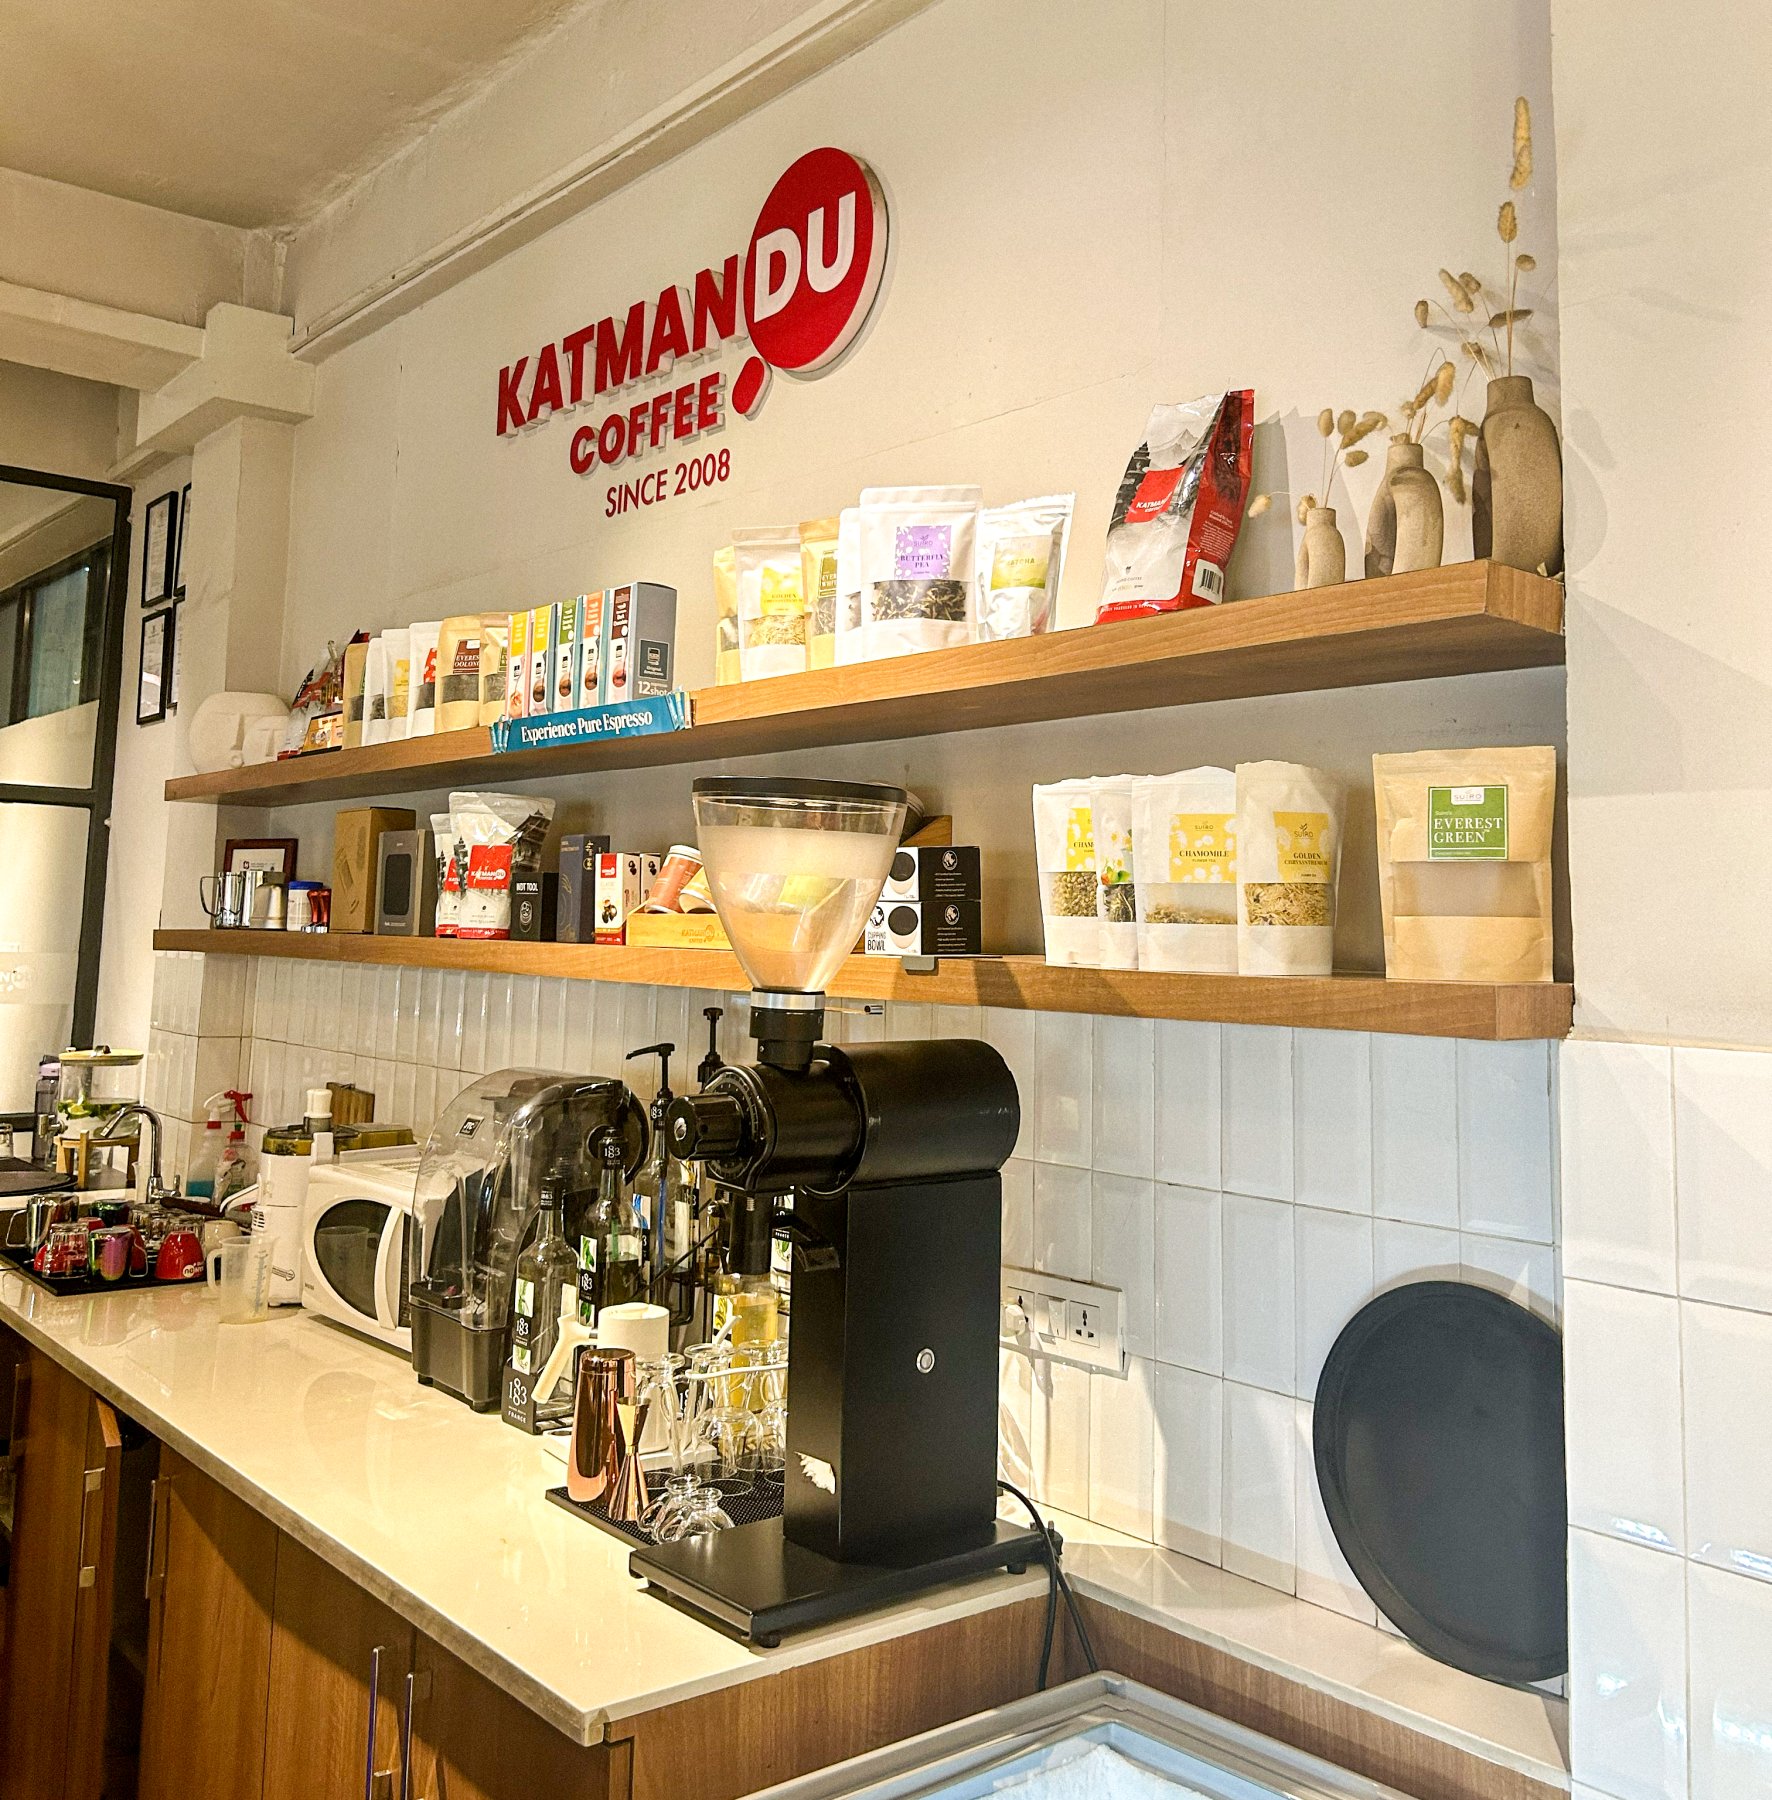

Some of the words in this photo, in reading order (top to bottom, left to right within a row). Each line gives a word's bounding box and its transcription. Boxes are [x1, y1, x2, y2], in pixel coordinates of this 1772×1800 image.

[570, 371, 722, 475] COFFEE
[605, 468, 667, 518] SINCE
[674, 448, 731, 496] 2008
[1007, 557, 1035, 566] ATCHA
[637, 681, 651, 695] 12
[520, 721, 577, 746] Experience
[577, 716, 603, 735] Pure
[602, 711, 653, 735] Espresso
[1434, 817, 1503, 830] EVEREST
[526, 882, 539, 892] TOOL
[867, 939, 886, 951] BOWL
[508, 1410, 527, 1424] FRANCE
